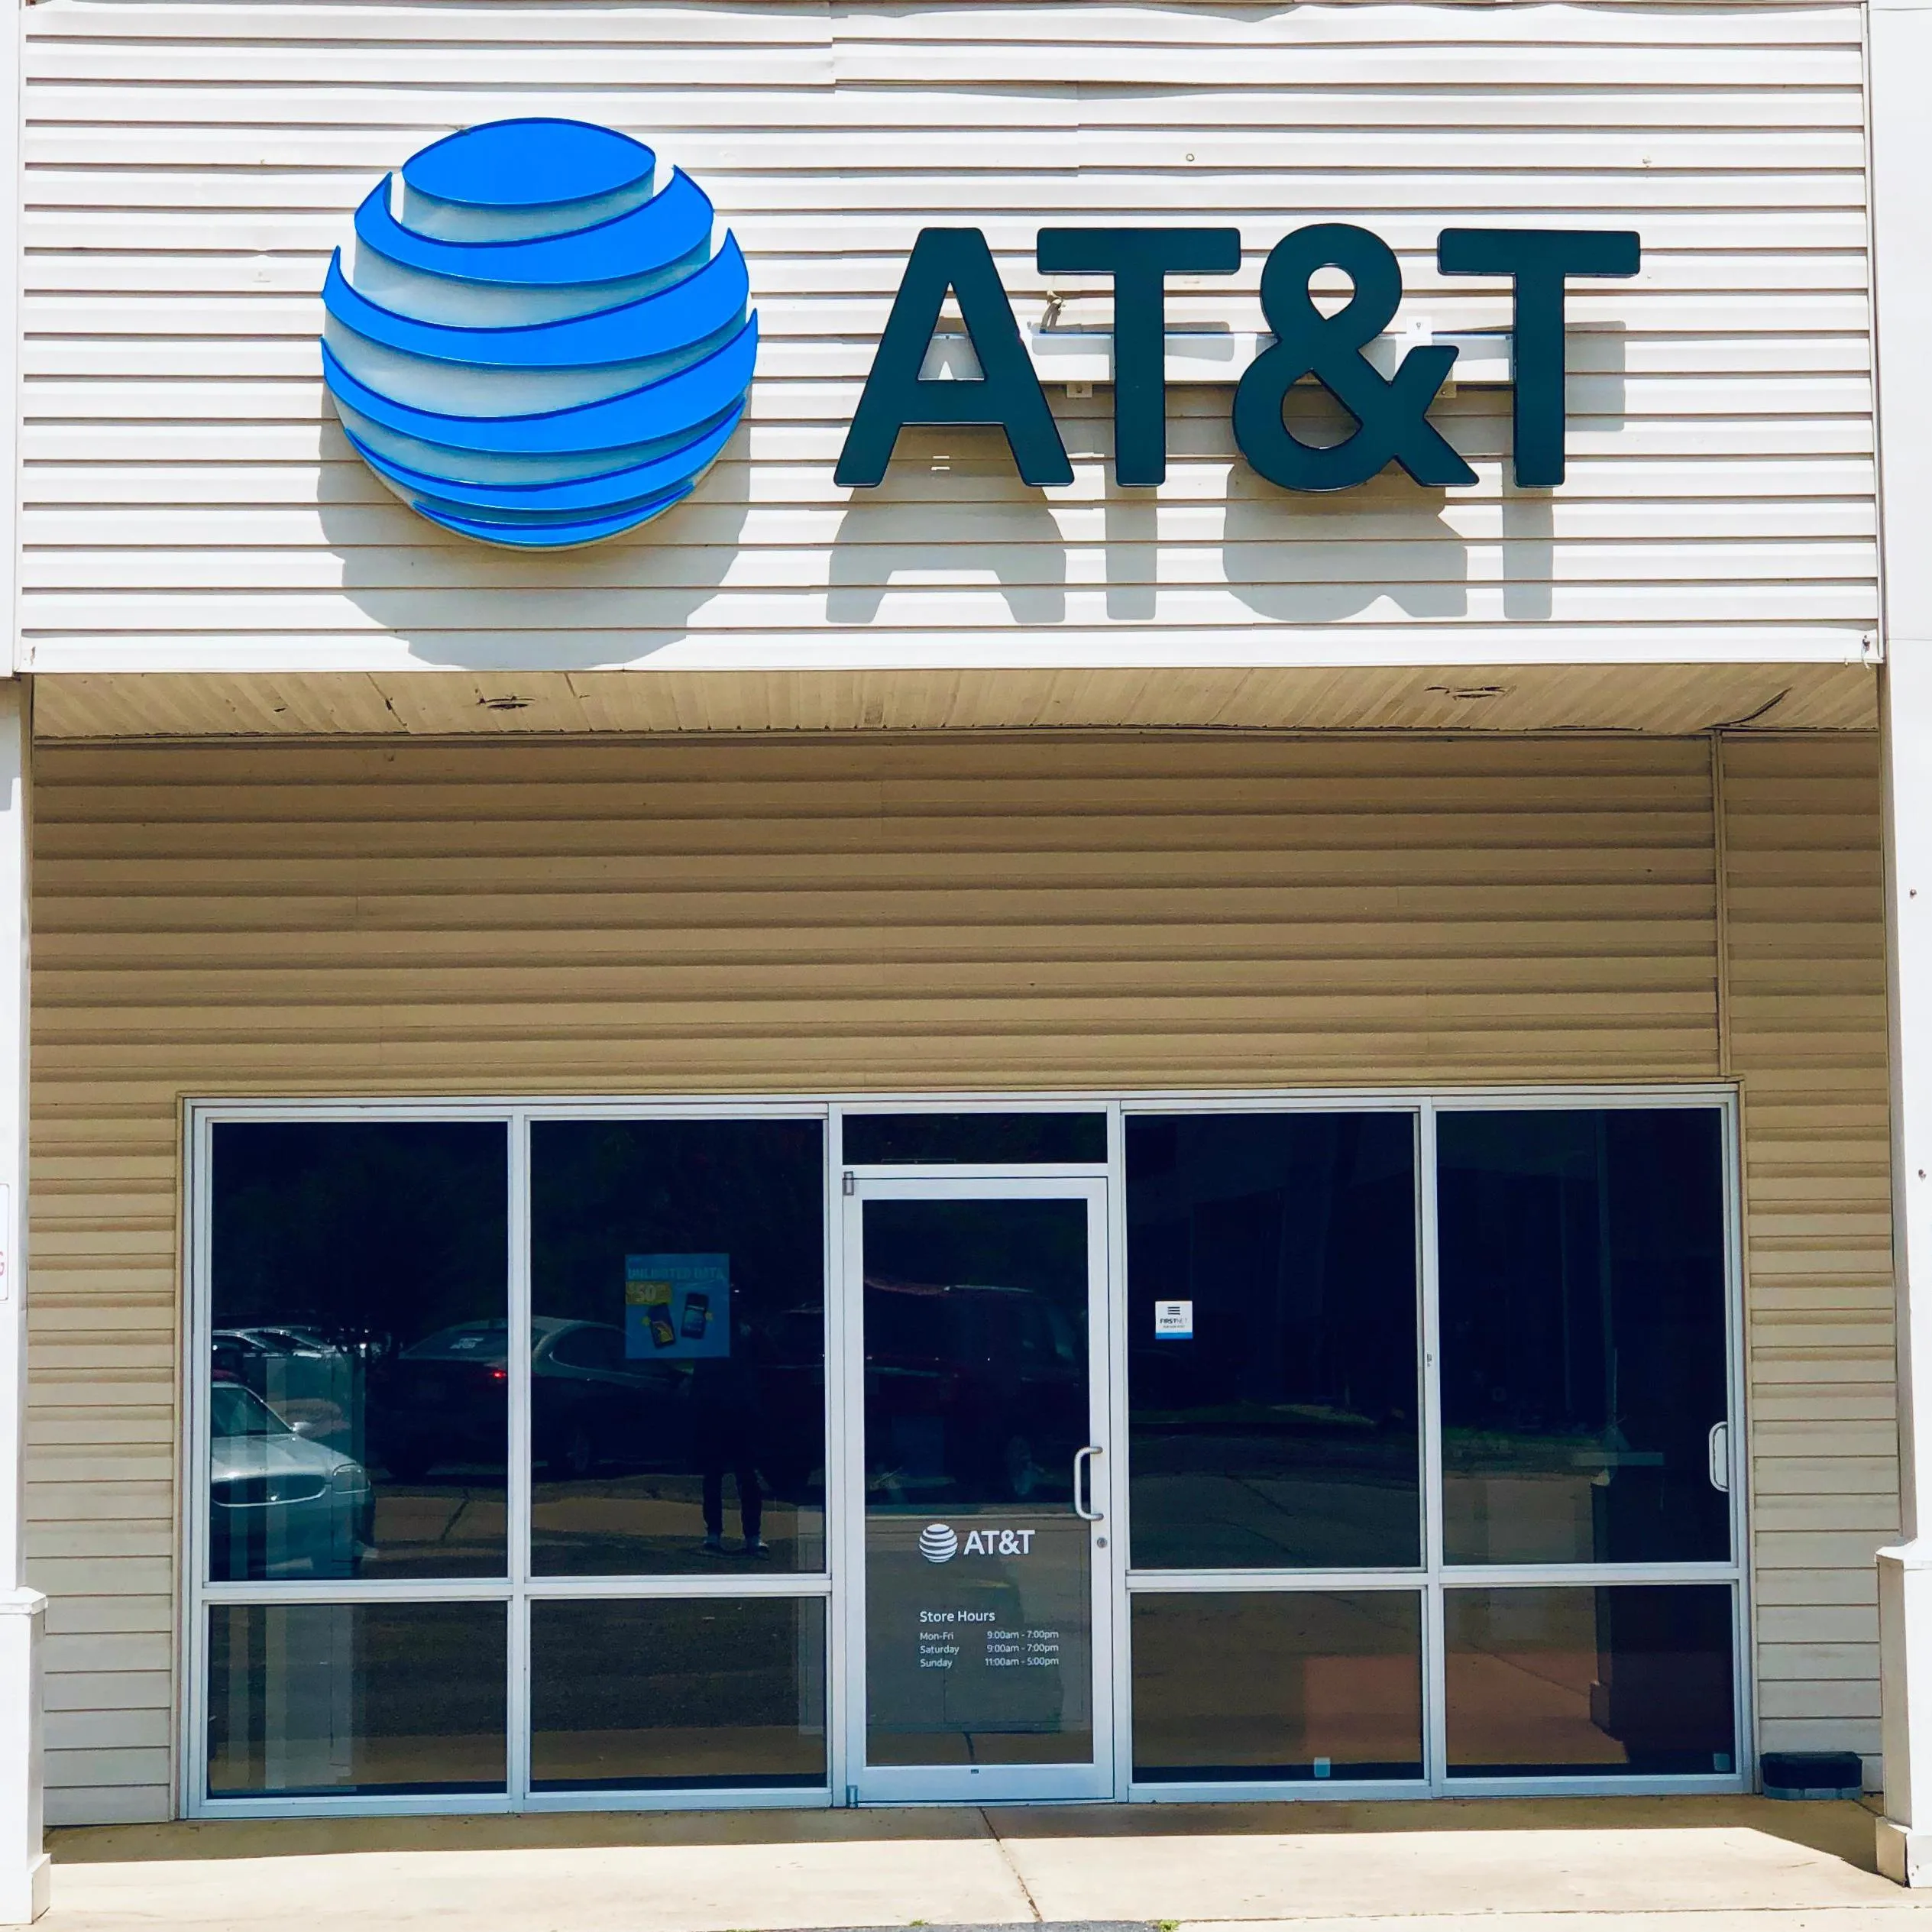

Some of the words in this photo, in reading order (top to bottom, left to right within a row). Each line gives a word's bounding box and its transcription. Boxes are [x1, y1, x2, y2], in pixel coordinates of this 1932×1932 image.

[833, 222, 1641, 494] AT&T
[963, 1529, 1035, 1555] AT&T
[919, 1610, 955, 1623] Store
[957, 1610, 995, 1623] Hours
[919, 1632, 954, 1641] Mon-Fri
[1027, 1630, 1060, 1640] 7:00pm
[919, 1645, 960, 1655] Saturday
[986, 1644, 1019, 1653] 9:00am
[1027, 1643, 1060, 1654] 7:00pm
[919, 1659, 953, 1668] Sunday
[985, 1658, 1019, 1666] 11:00am
[1027, 1657, 1060, 1667] 5:00pm
